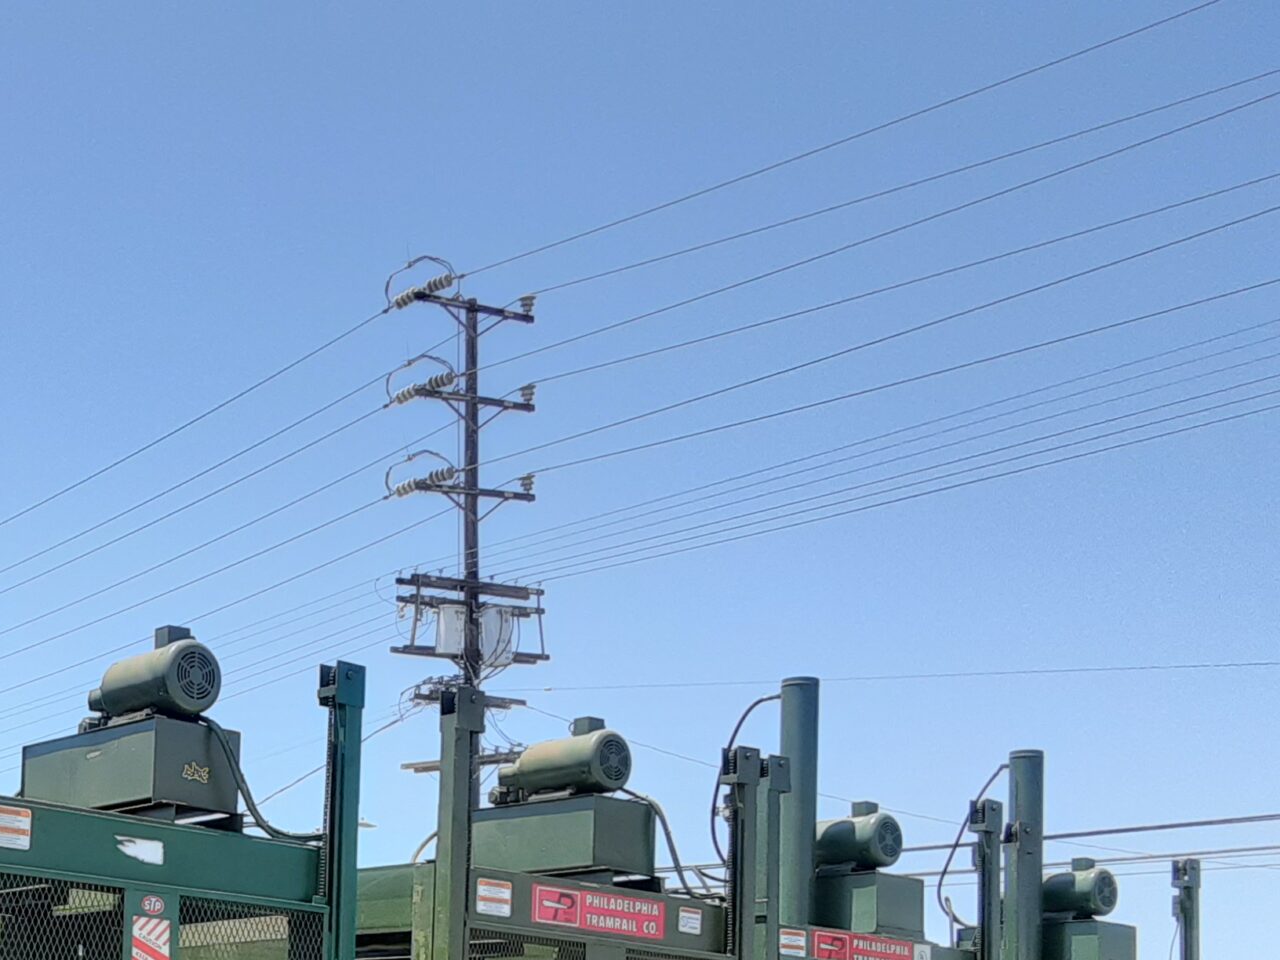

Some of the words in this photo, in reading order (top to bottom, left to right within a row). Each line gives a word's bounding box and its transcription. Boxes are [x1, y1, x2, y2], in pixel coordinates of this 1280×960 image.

[144, 897, 161, 911] STP
[586, 894, 659, 916] PHILADELPHIA
[586, 914, 637, 932] TRAMRAIL
[643, 921, 659, 935] CO.
[853, 939, 909, 956] PHILADELPHIA
